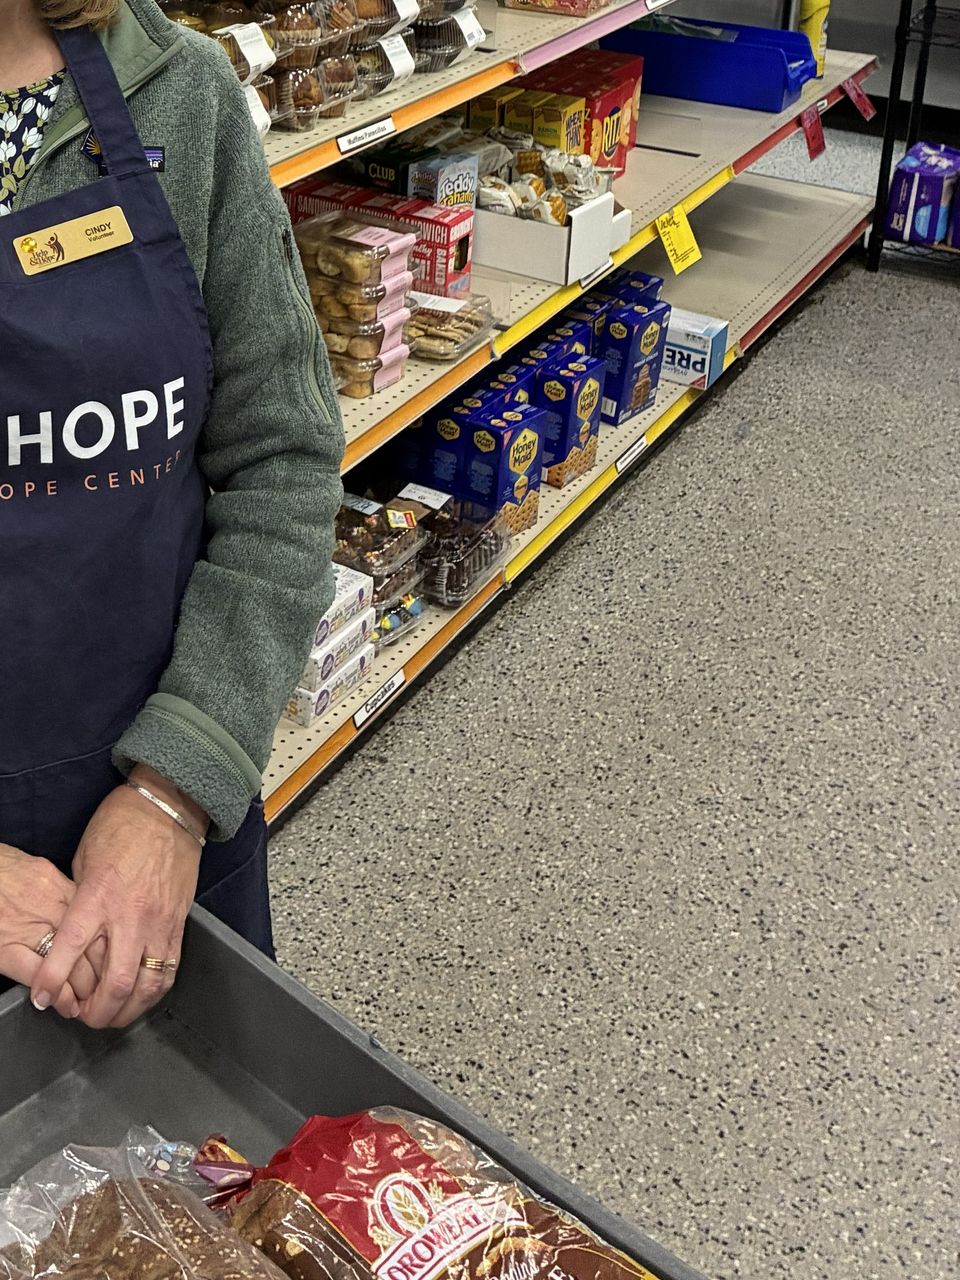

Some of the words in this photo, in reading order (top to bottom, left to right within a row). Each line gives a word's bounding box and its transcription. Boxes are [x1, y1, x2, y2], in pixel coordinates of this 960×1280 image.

[602, 110, 622, 153] RITZ
[368, 163, 395, 181] CLUB
[442, 172, 474, 198] Teddy
[85, 222, 112, 237] CINDY
[88, 230, 114, 243] Volunteer
[399, 216, 448, 244] SANDWICH
[32, 249, 49, 260] Help
[643, 330, 658, 341] Honey
[643, 337, 656, 347] Maid
[581, 389, 598, 403] Honey
[581, 399, 594, 412] Maid
[512, 439, 536, 456] Honey
[513, 452, 532, 468] Maid
[365, 681, 396, 714] Cupcakes
[386, 1204, 483, 1280] OROWEAT
